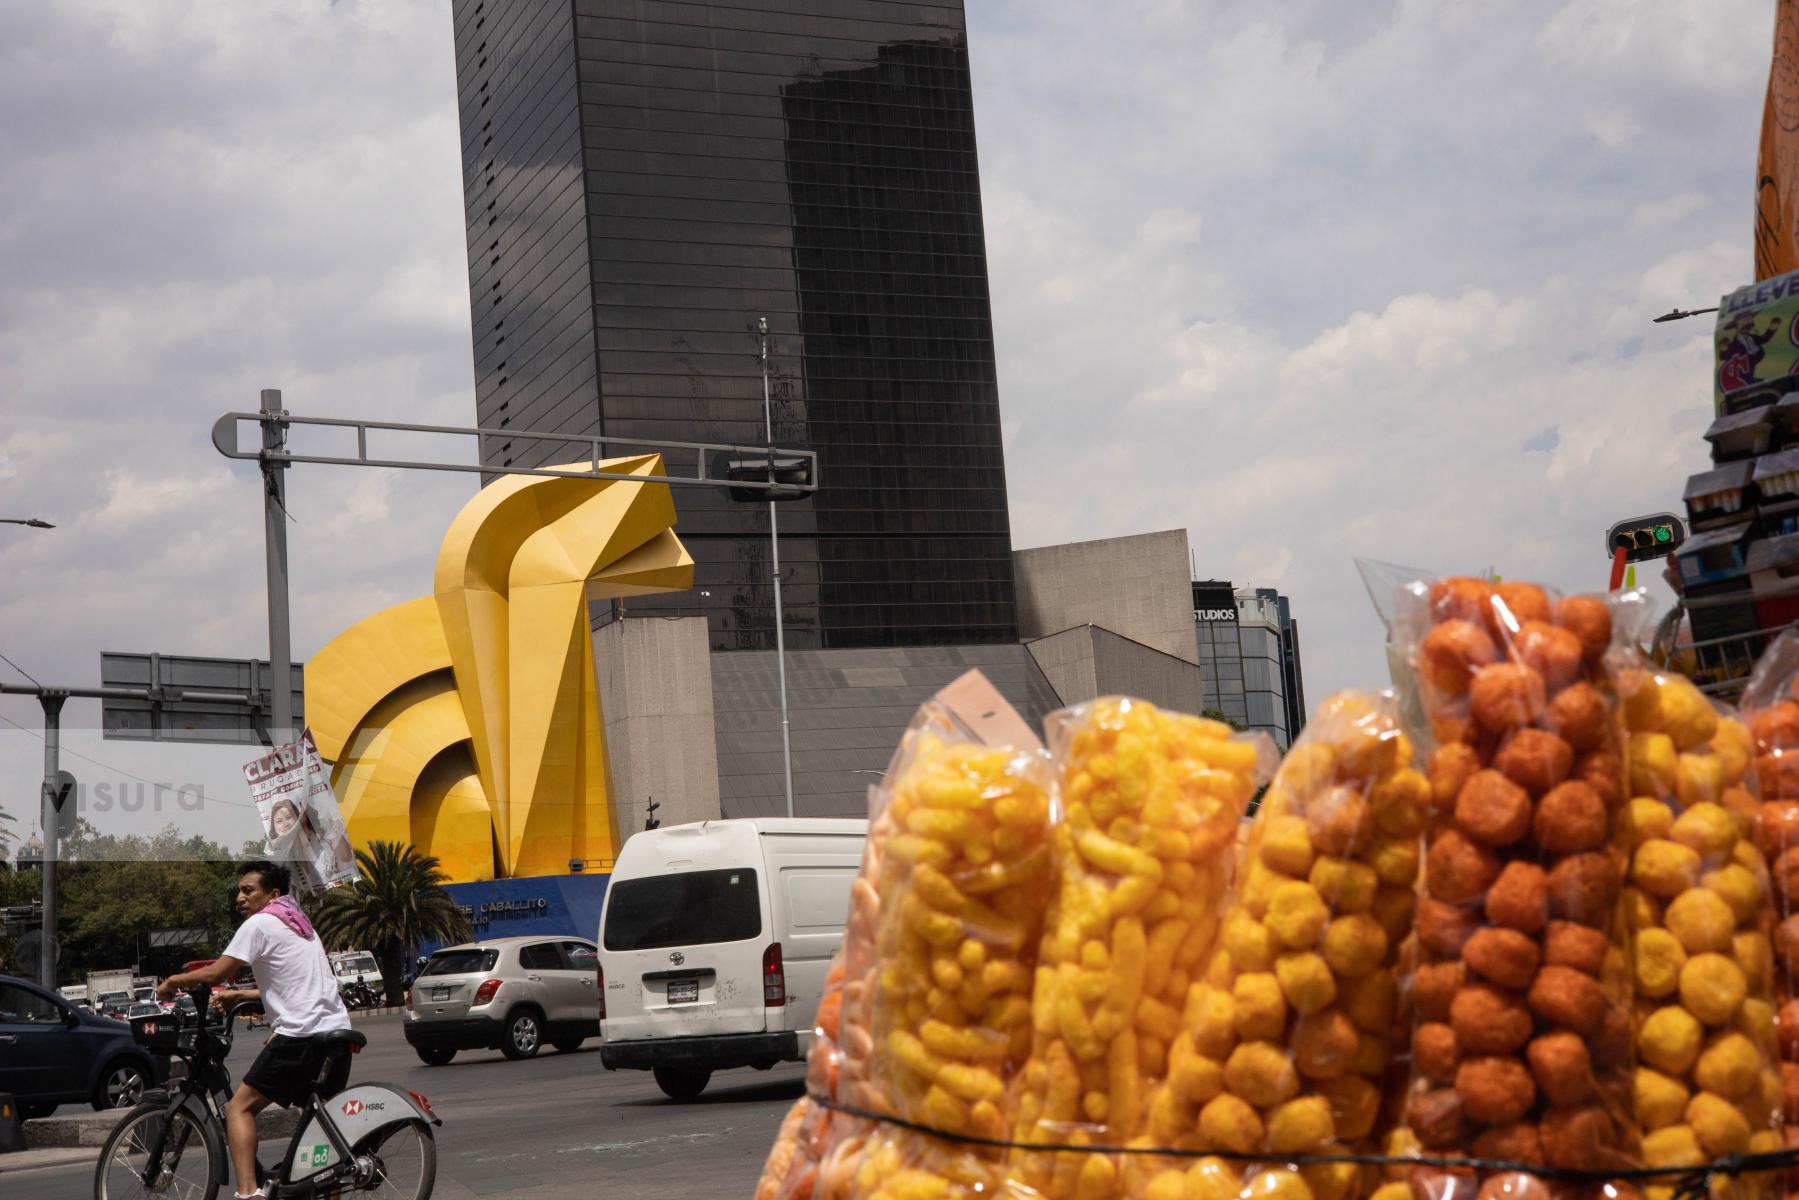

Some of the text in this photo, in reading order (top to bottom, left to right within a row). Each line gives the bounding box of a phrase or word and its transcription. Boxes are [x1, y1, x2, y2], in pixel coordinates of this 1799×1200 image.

[245, 737, 314, 781] CLARA
[480, 898, 546, 912] CABALLITO
[365, 1103, 384, 1111] HSBC
